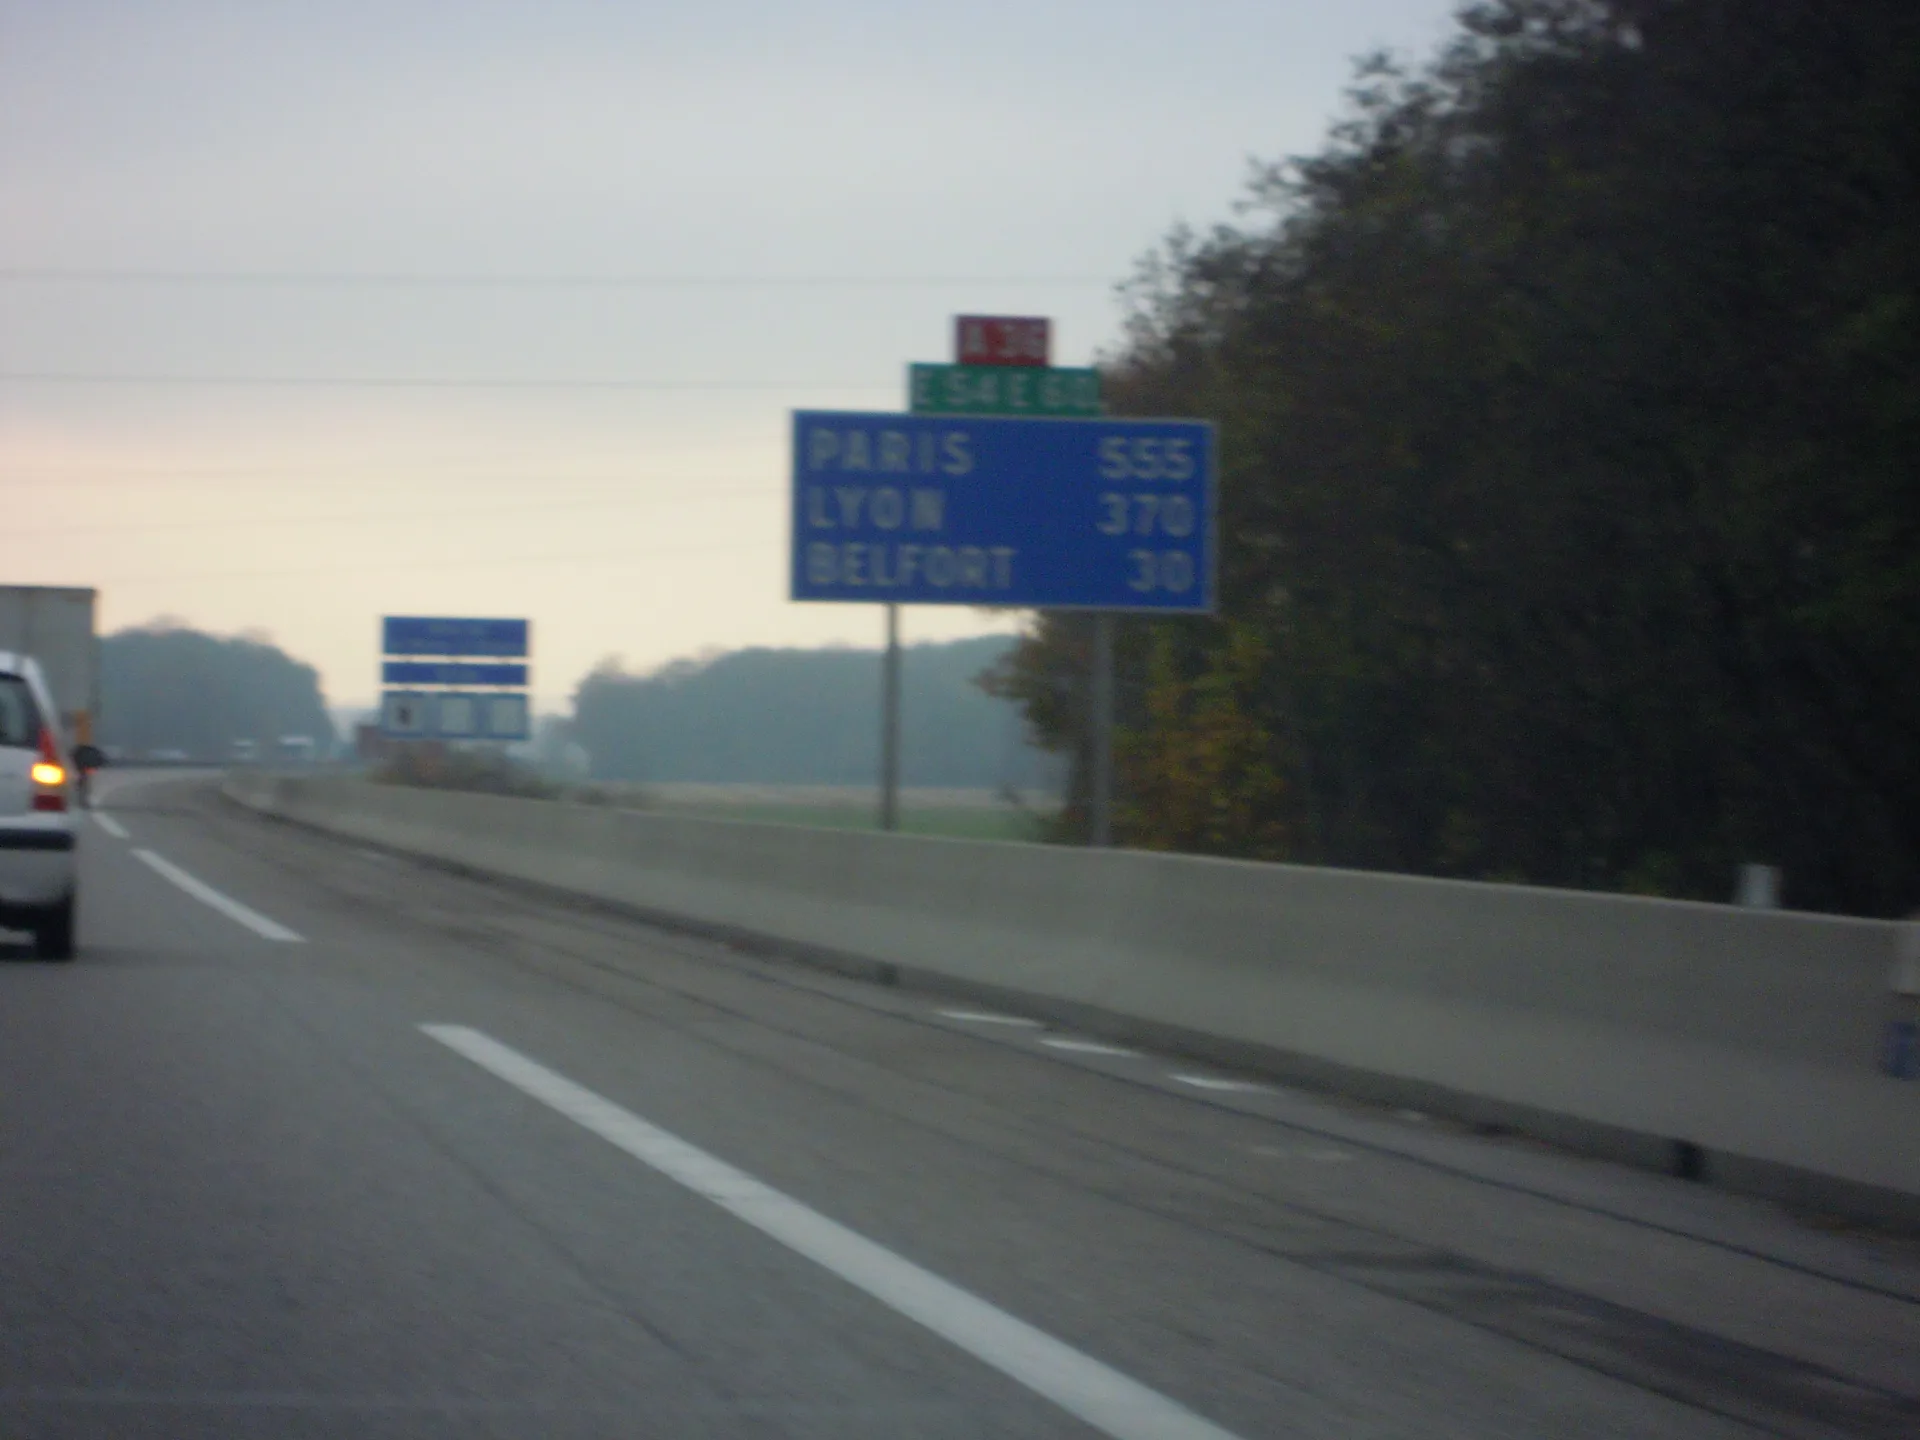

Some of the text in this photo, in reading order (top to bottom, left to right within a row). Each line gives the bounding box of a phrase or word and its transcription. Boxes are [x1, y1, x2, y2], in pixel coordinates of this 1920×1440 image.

[1009, 372, 1031, 407] E
[807, 428, 1195, 480] PARIS 555
[807, 486, 1195, 538] LYON 370
[806, 541, 1196, 593] BELFORT 30
